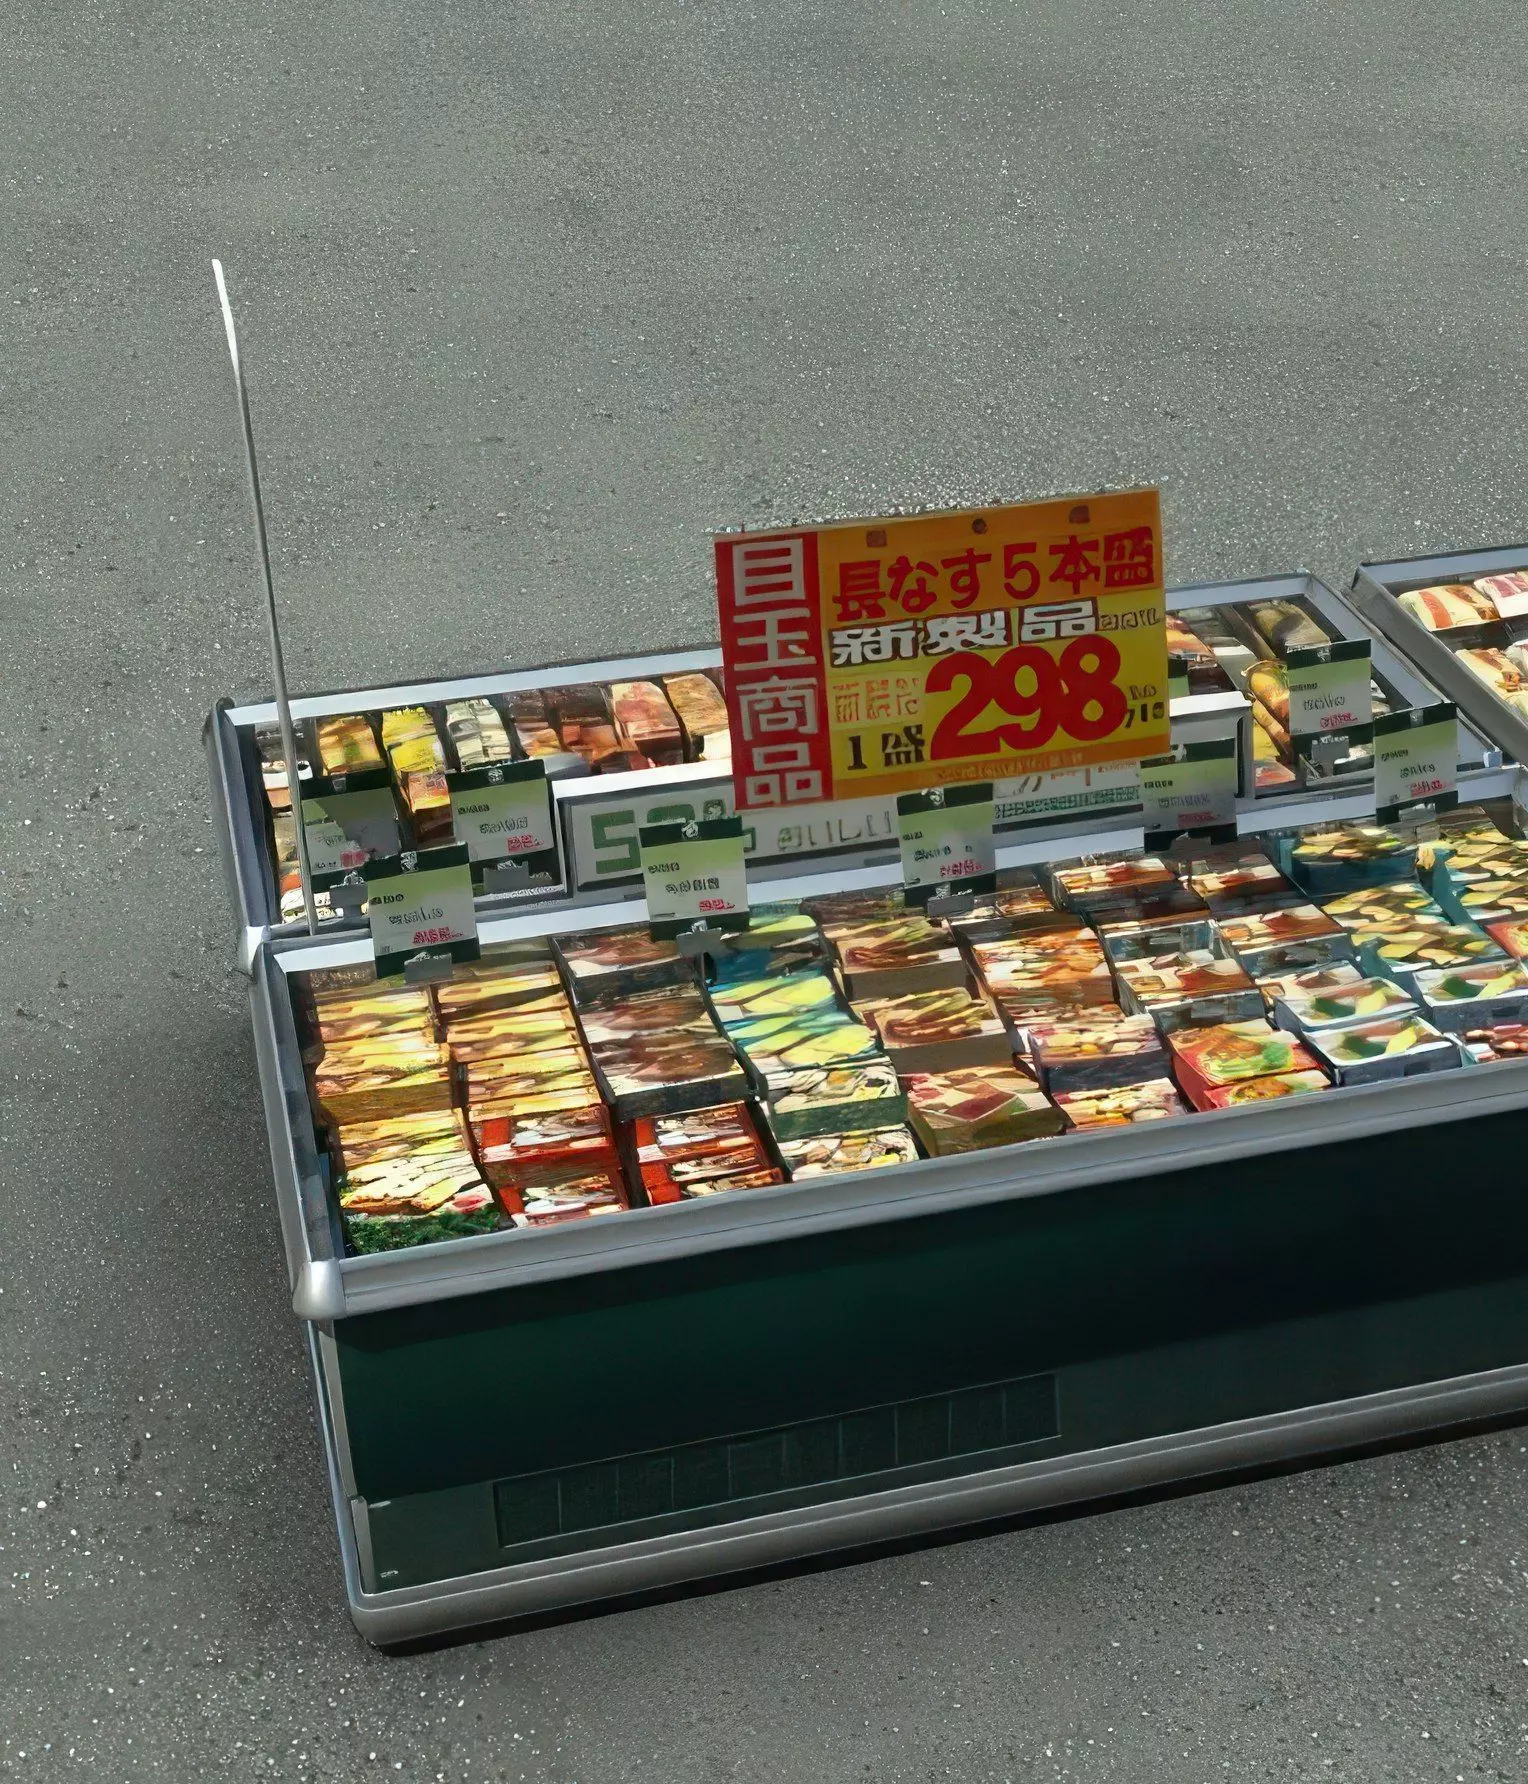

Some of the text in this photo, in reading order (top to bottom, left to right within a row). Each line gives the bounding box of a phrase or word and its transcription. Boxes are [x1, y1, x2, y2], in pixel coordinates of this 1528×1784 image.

[732, 537, 823, 807] 目玉商品
[925, 634, 1128, 761] 298
